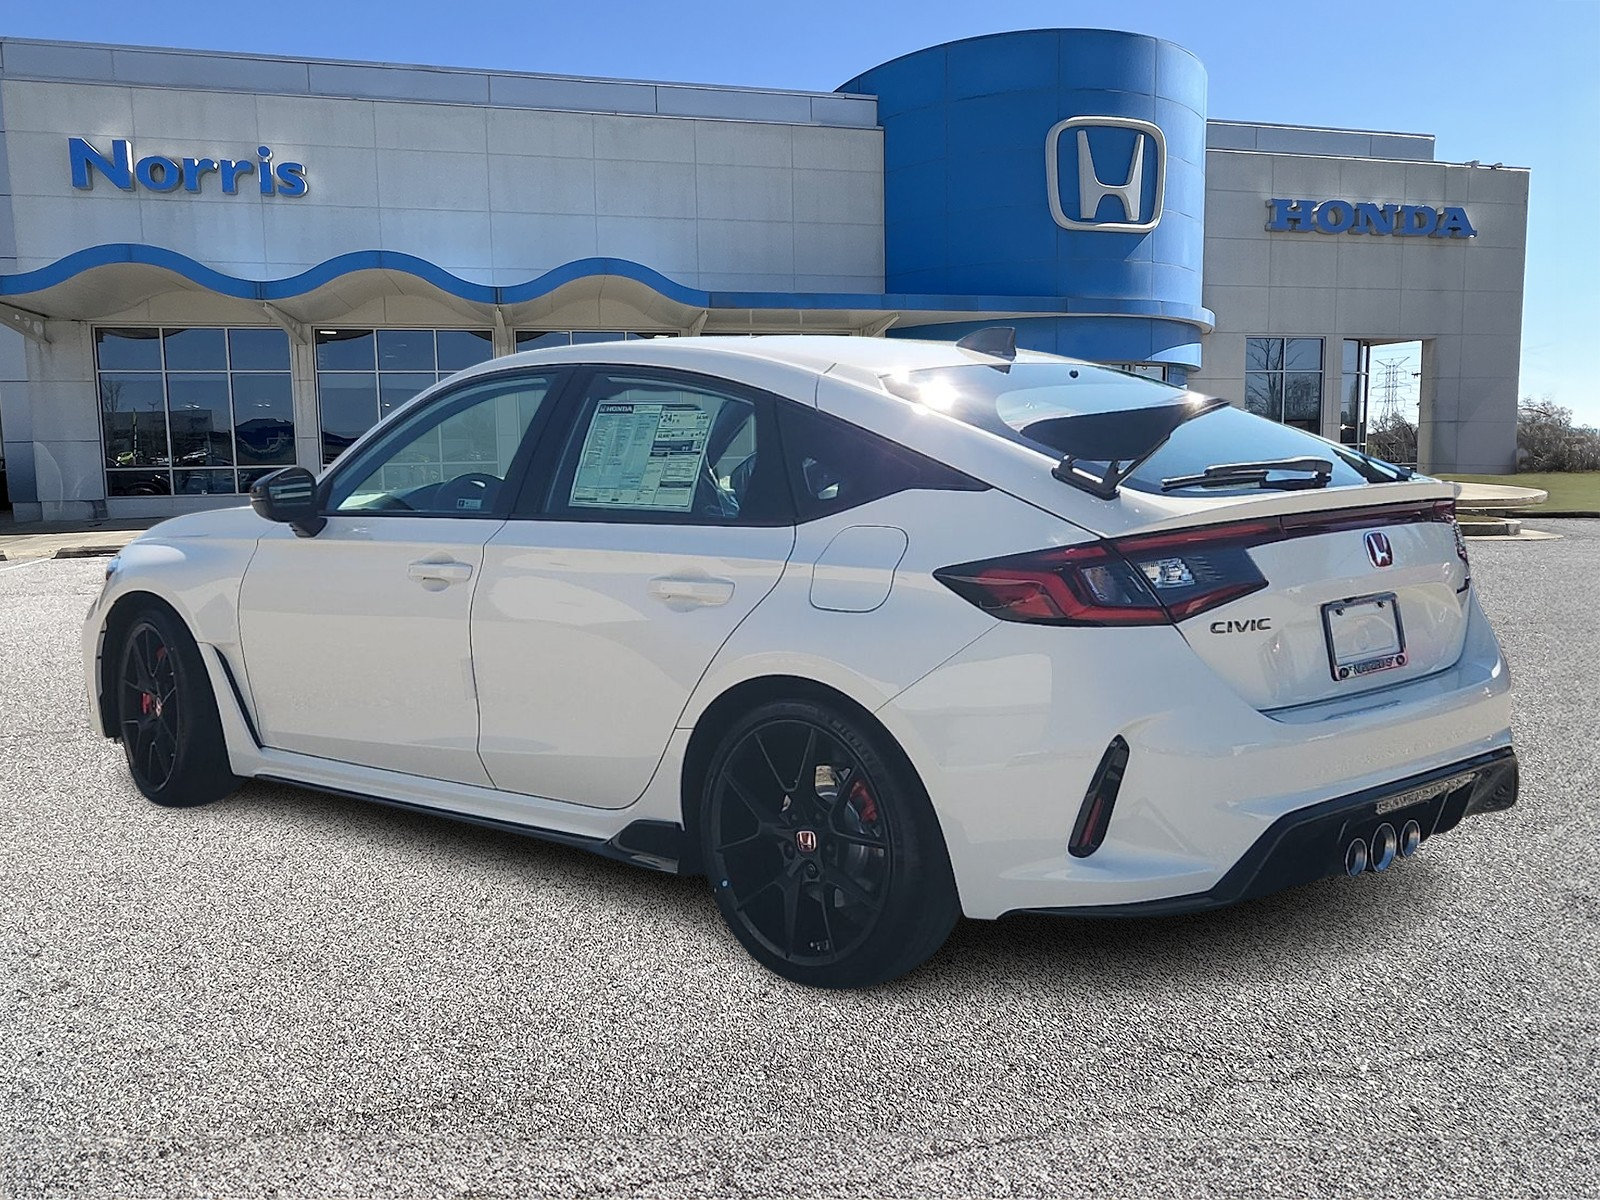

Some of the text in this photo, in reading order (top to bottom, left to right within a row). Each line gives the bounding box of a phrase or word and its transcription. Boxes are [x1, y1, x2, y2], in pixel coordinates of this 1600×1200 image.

[68, 137, 308, 197] Norris
[1265, 198, 1478, 238] HONDA
[1210, 618, 1272, 634] CIVIC
